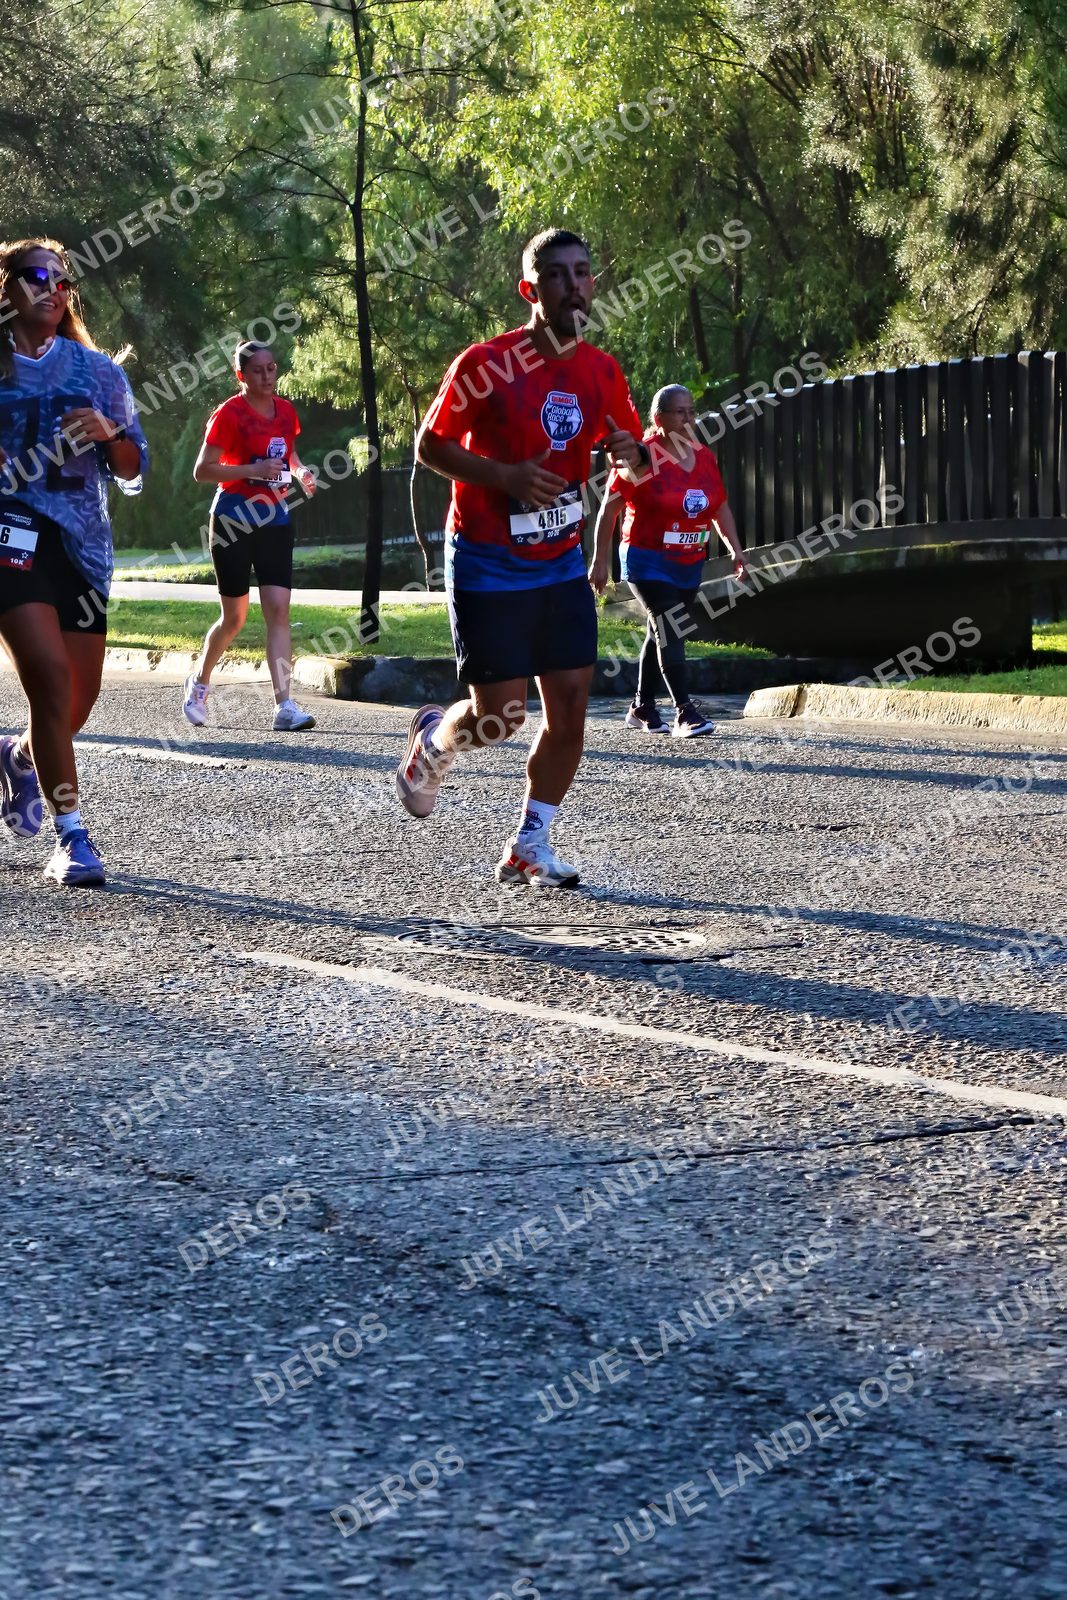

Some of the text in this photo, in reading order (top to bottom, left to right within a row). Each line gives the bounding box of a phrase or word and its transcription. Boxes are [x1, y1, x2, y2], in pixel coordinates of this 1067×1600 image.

[552, 405, 574, 417] Global
[547, 412, 564, 423] Race
[538, 507, 567, 529] 4815
[679, 533, 699, 544] 2750
[10, 557, 24, 566] 10K
